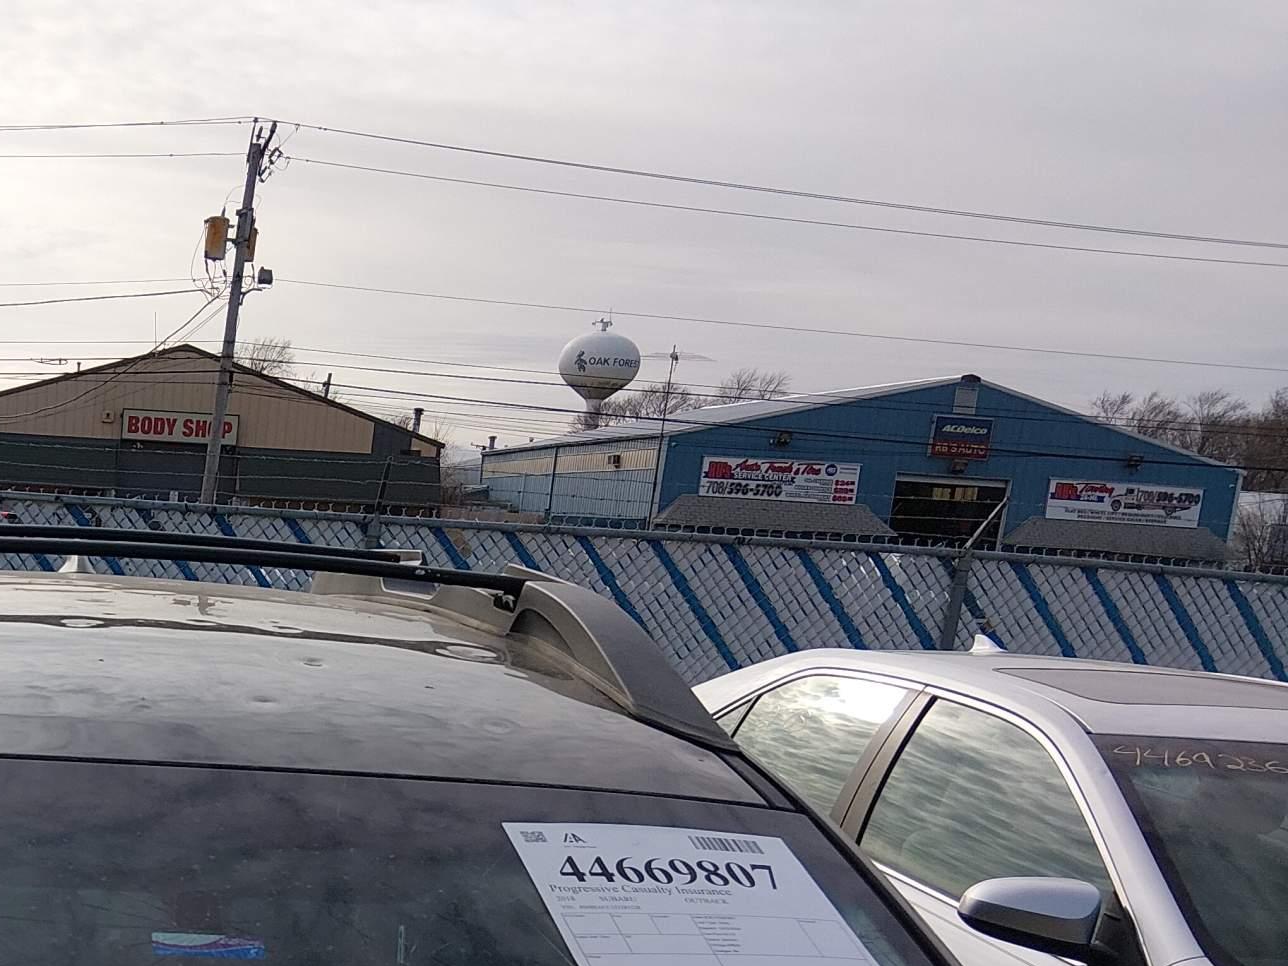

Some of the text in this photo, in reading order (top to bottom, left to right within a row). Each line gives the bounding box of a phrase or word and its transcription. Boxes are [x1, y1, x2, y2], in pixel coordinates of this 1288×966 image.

[588, 356, 610, 366] OAK
[127, 415, 178, 435] BODY
[942, 424, 988, 434] ACDelco
[734, 471, 792, 481] SERVICE CENTER
[559, 855, 778, 890] 44669807
[549, 884, 733, 897] Progressive Casualty Insurance
